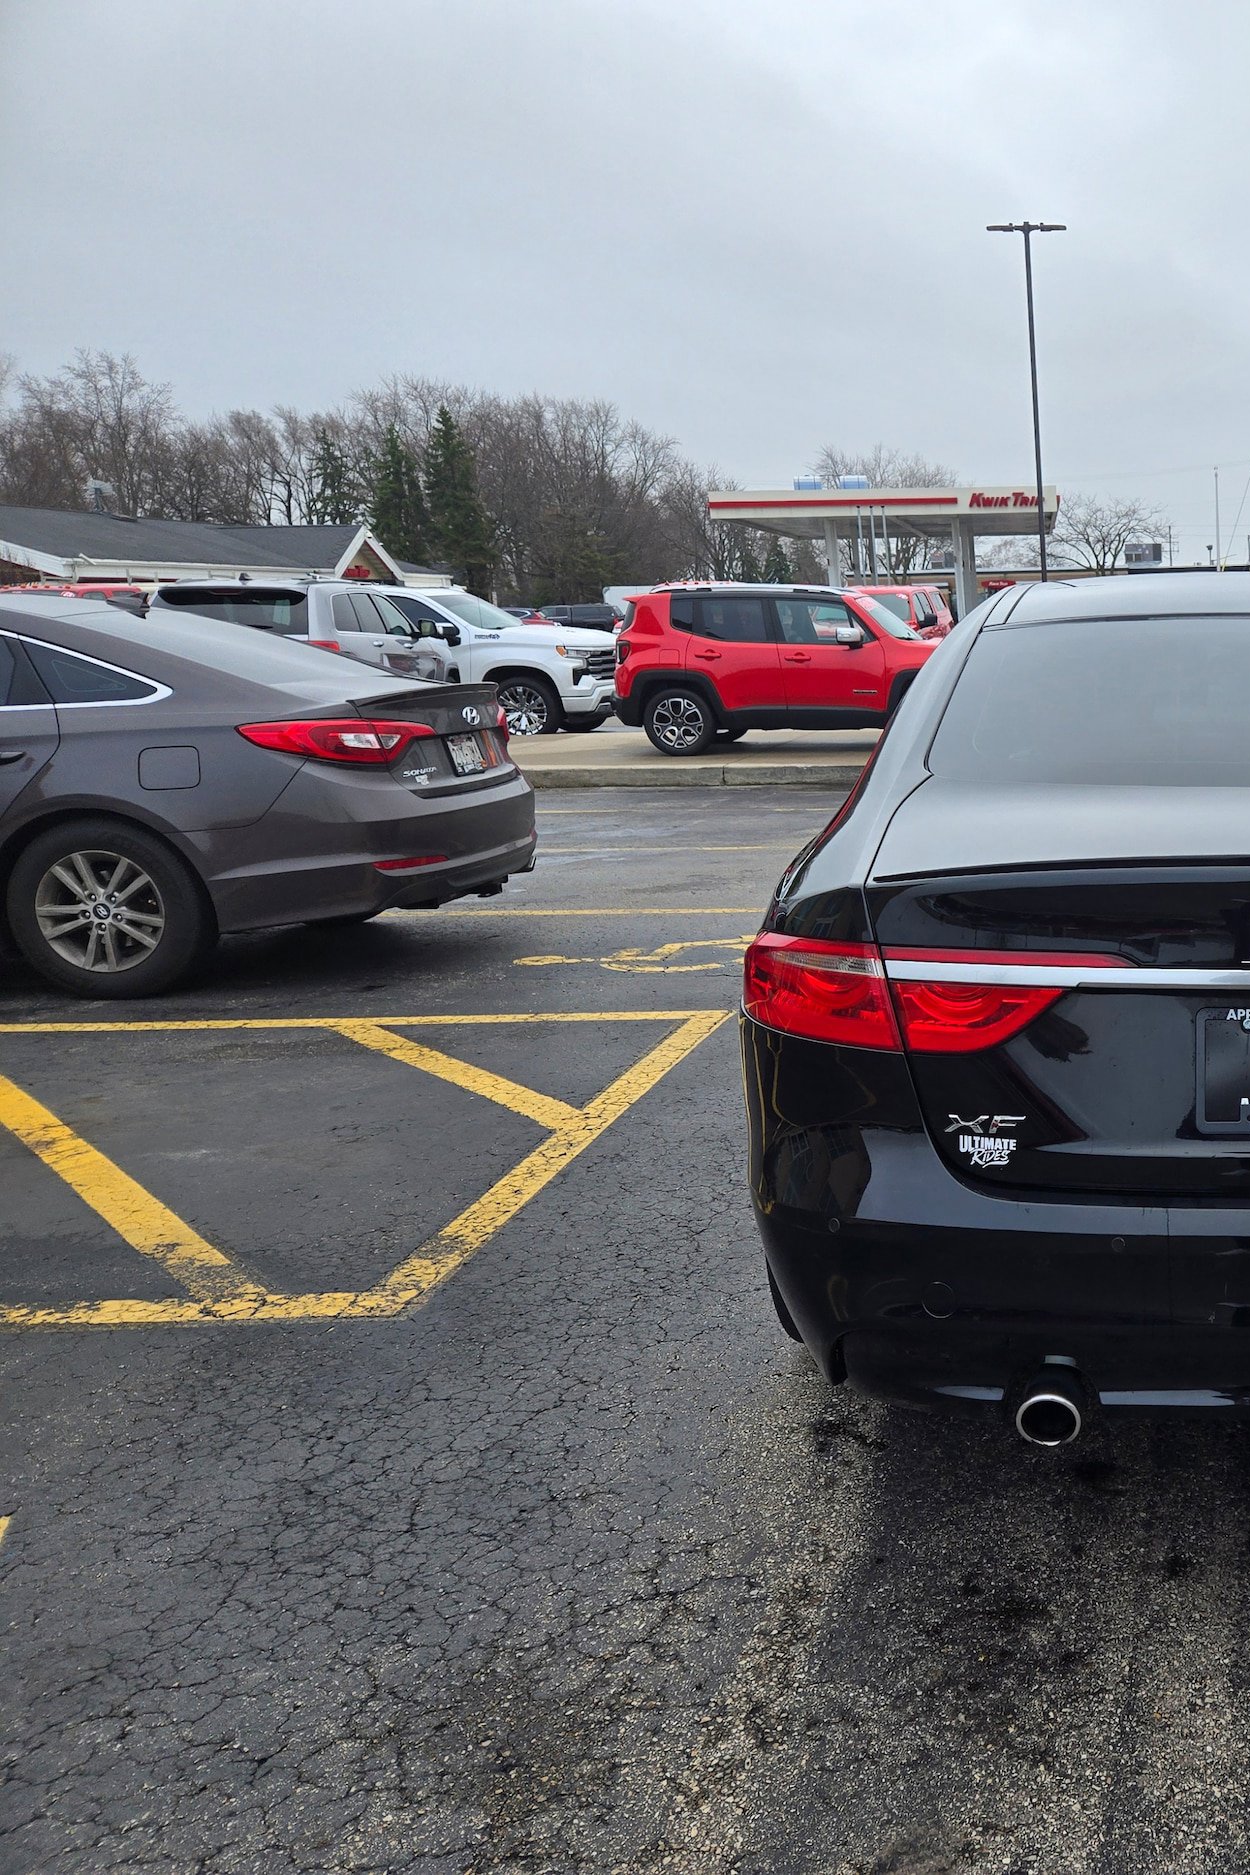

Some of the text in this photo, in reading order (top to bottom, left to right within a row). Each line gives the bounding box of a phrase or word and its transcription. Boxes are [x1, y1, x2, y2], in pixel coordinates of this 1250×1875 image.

[969, 492, 1011, 508] KWIK
[402, 766, 437, 778] SONATA
[944, 1114, 1026, 1133] XF
[958, 1134, 1017, 1153] ULTIMATE
